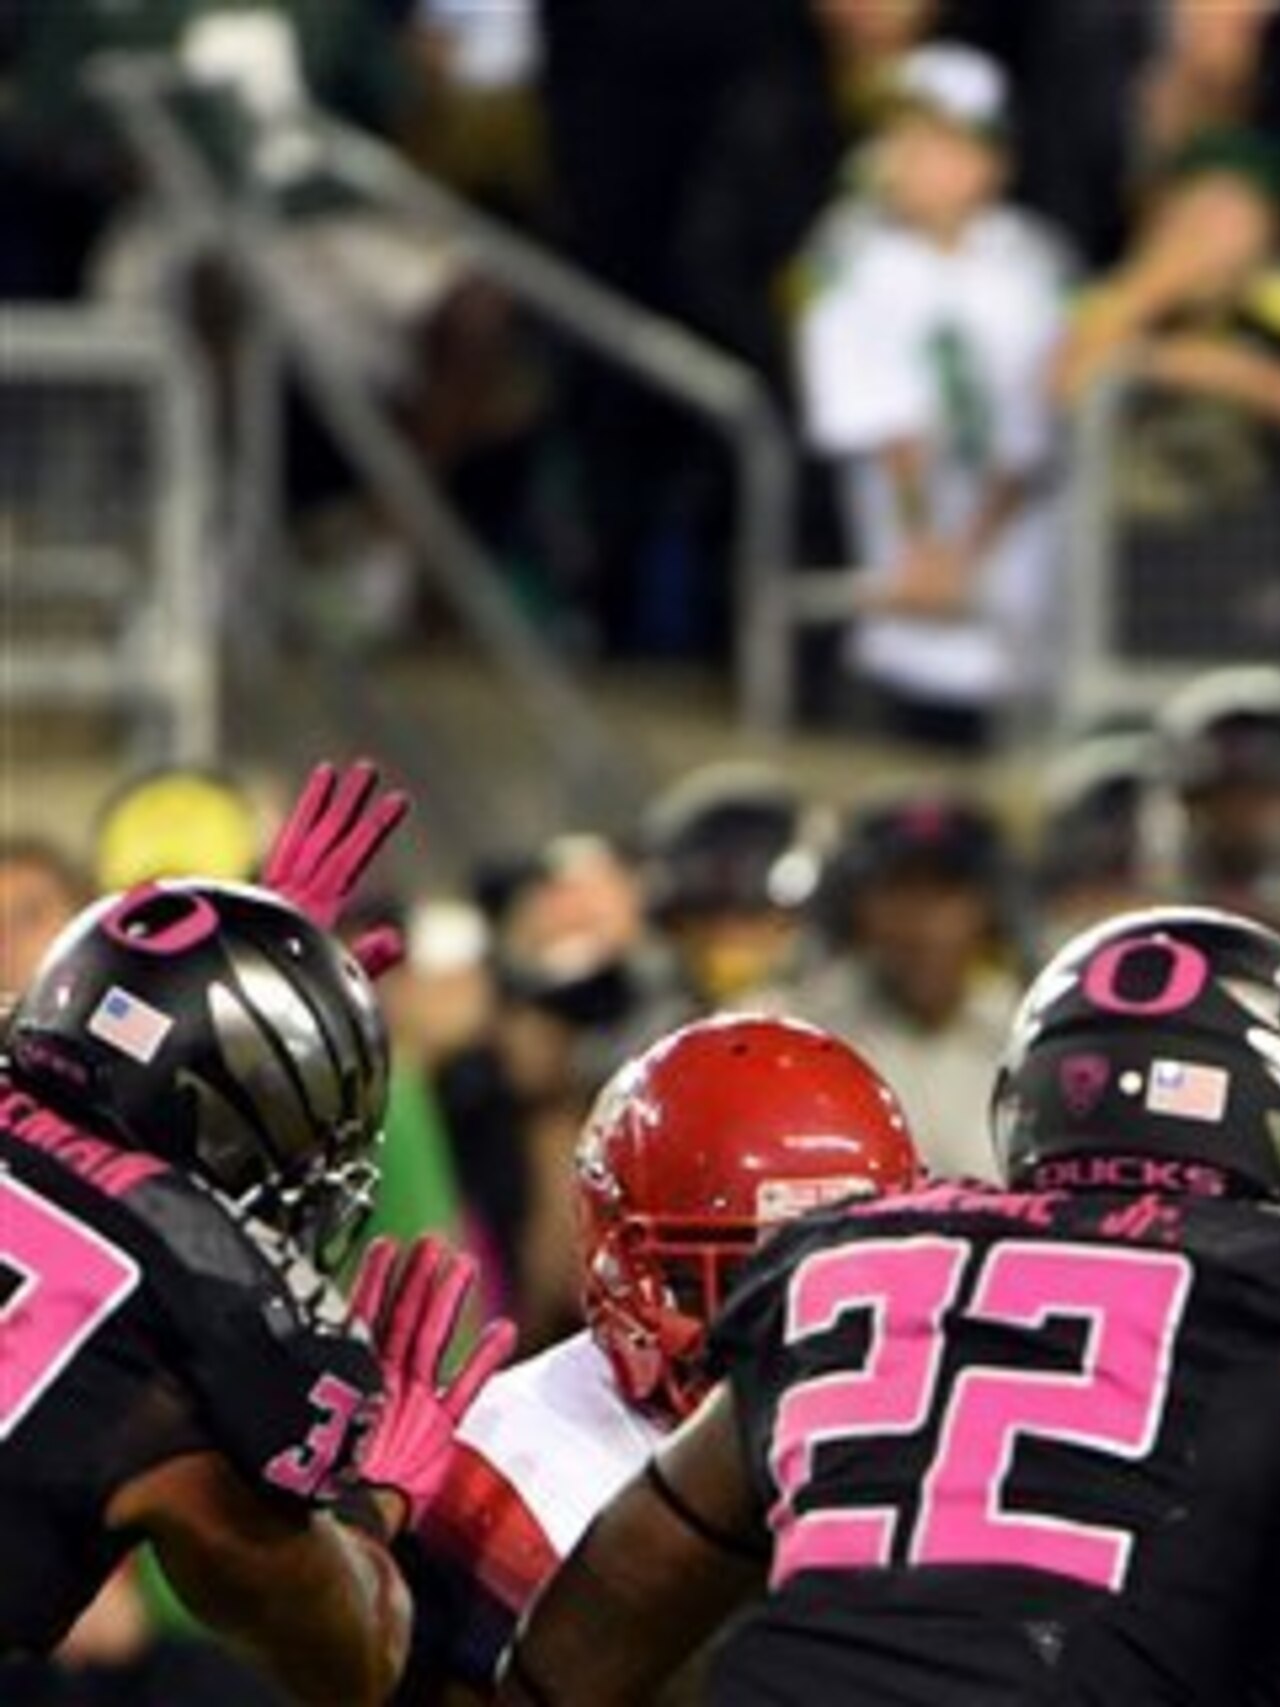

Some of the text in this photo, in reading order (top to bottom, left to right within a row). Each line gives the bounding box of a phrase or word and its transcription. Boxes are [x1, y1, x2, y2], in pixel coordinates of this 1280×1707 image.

[1085, 936, 1208, 1015] O
[1035, 1154, 1222, 1196] DUCKS
[263, 1372, 366, 1500] 3
[770, 1237, 1192, 1593] 22
